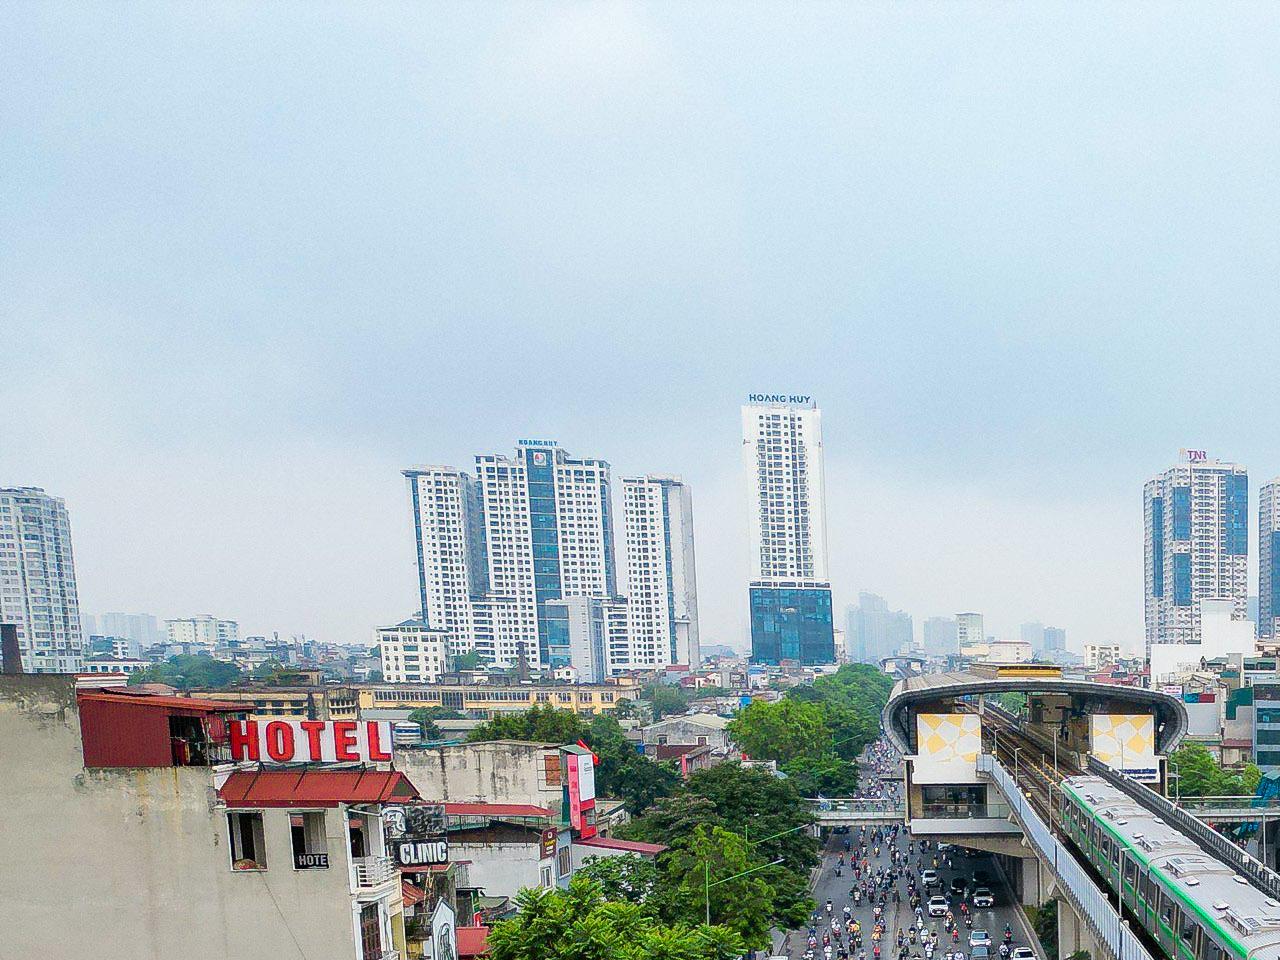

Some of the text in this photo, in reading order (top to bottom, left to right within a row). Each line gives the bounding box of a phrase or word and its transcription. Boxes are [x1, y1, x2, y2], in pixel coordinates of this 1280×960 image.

[789, 395, 811, 403] HUY
[228, 720, 392, 762] HOTEL
[400, 842, 447, 865] CLINIC
